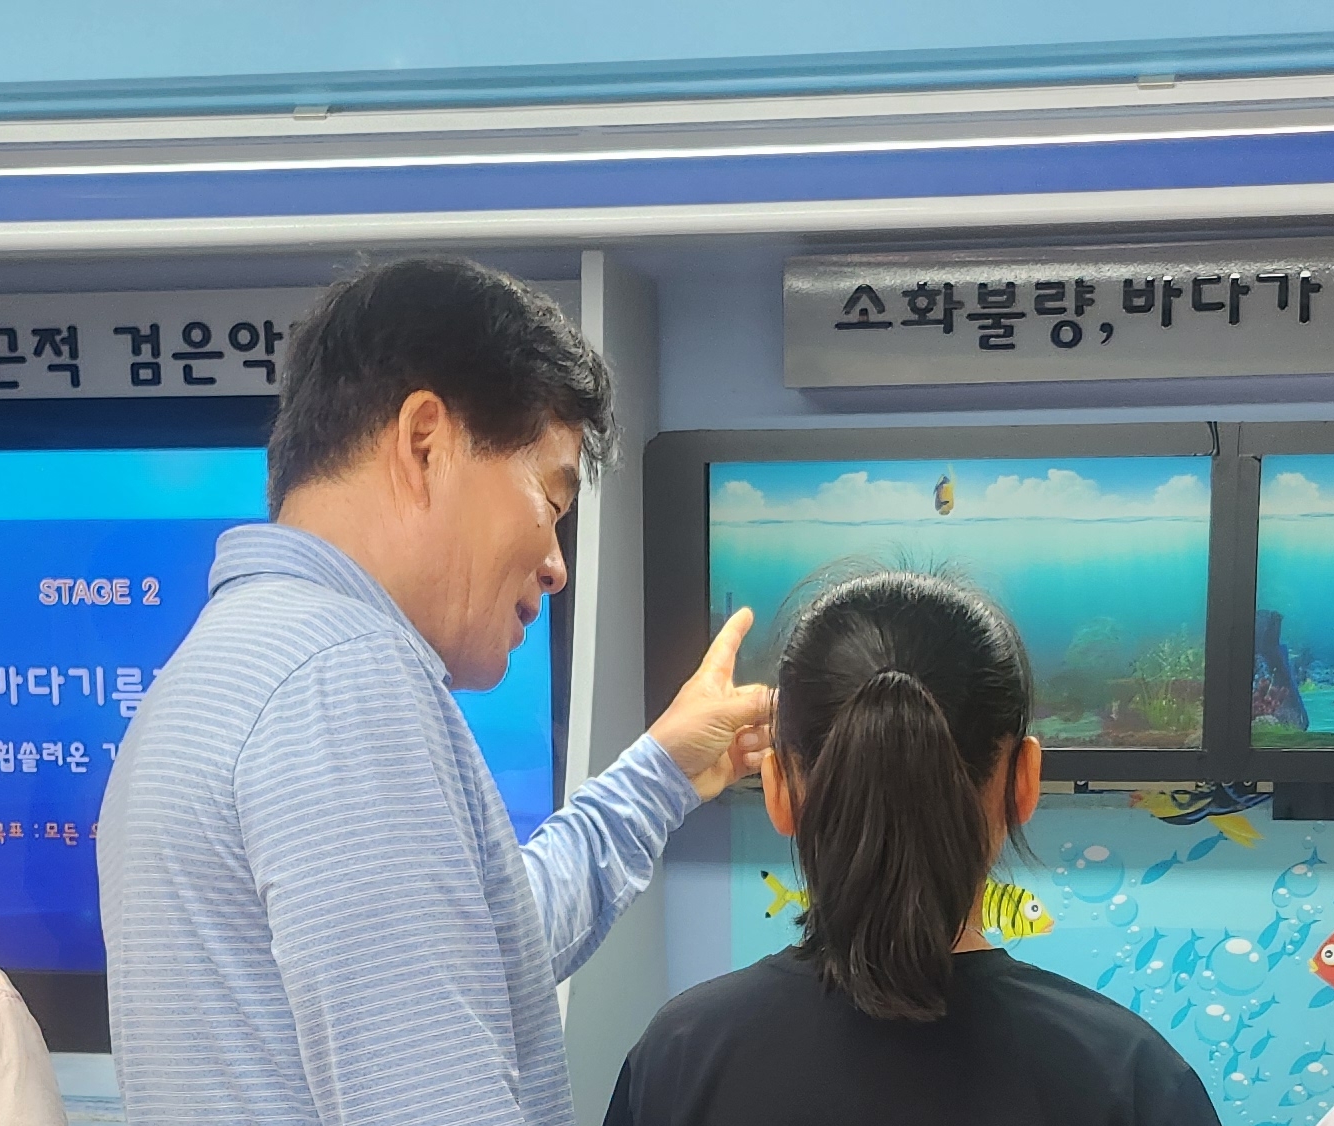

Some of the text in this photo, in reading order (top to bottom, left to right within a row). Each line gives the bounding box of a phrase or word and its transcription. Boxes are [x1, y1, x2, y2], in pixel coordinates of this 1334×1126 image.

[113, 320, 284, 387] 검은악
[38, 577, 161, 605] STAGE 2
